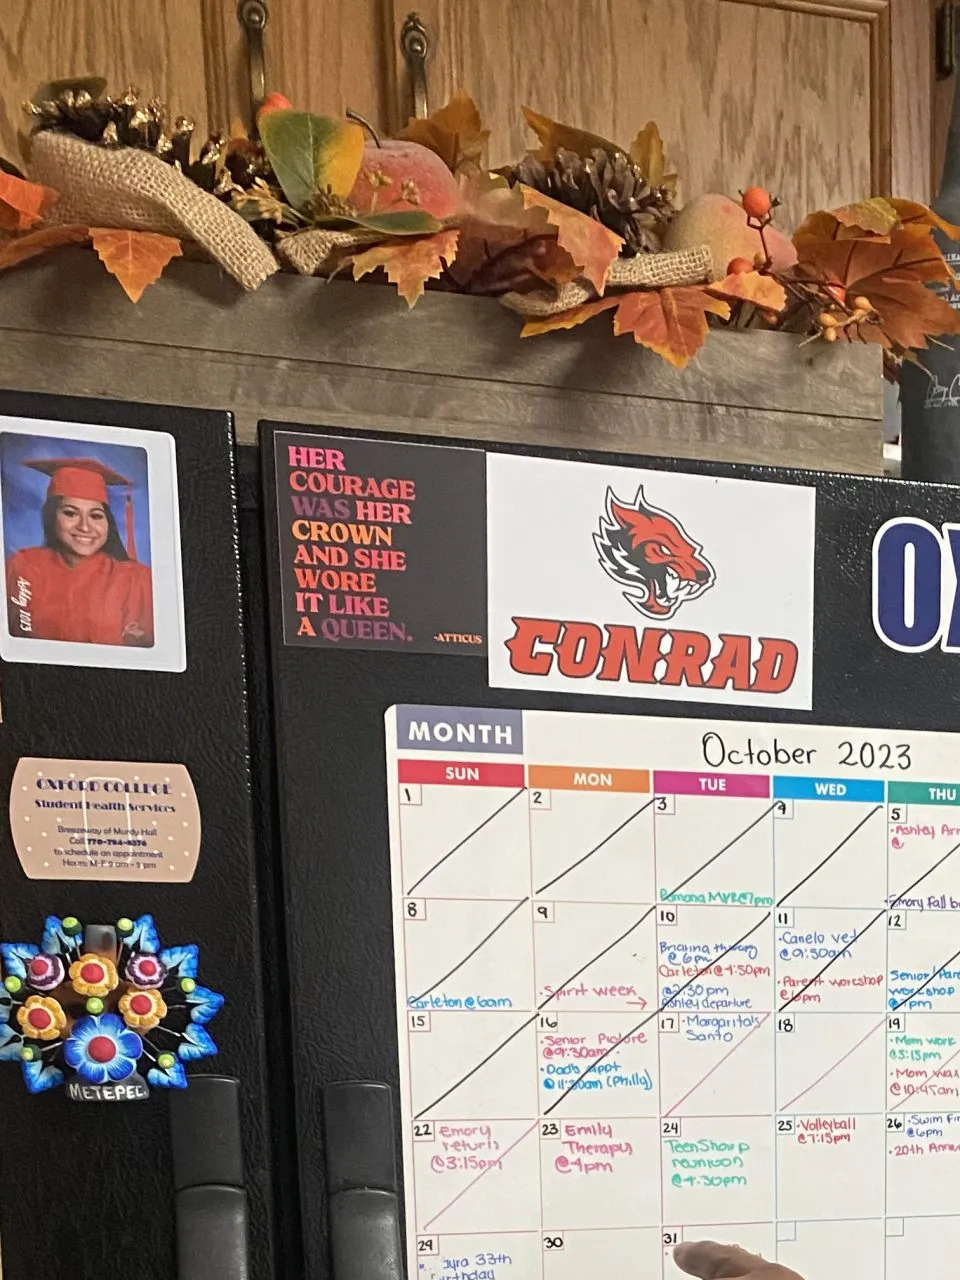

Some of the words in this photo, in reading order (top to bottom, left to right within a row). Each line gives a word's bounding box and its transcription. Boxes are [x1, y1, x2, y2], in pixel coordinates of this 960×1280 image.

[288, 446, 346, 471] HER
[290, 471, 416, 500] COURAGE
[291, 495, 350, 519] WAS
[356, 500, 412, 524] HER
[292, 520, 392, 546] CROWN
[294, 544, 348, 566] AND
[354, 549, 406, 571] SHE
[294, 568, 377, 593] WORE
[296, 593, 323, 612] IT
[329, 594, 390, 618] LIKE
[298, 616, 316, 637] A
[322, 618, 413, 642] QUEEN.
[434, 633, 482, 644] -ATTICUS
[503, 617, 799, 694] CONRAD
[409, 722, 512, 745] MONTH
[703, 732, 816, 767] October
[838, 741, 911, 770] 2023
[36, 778, 99, 792] OXFORD
[104, 781, 171, 794] COLLEGE
[445, 767, 479, 780] SUN
[573, 773, 612, 786] MON
[699, 778, 726, 792] TUE
[815, 783, 846, 796] WED
[929, 787, 956, 800] THU
[405, 788, 411, 801] 1
[533, 792, 542, 804] 2
[35, 800, 81, 810] Student
[128, 803, 176, 812] Services
[657, 797, 667, 810] 3
[891, 808, 900, 820] 5
[407, 903, 417, 917] 8
[537, 906, 547, 919] 9
[661, 910, 675, 922] 10
[779, 913, 788, 924] 11
[888, 915, 901, 926] 12
[783, 931, 824, 944] Canelo
[783, 976, 824, 987] Parent
[593, 985, 637, 996] week
[702, 997, 752, 1009] departure
[411, 1016, 425, 1027] 15
[541, 1017, 558, 1028] 16
[662, 1018, 673, 1029] 17
[778, 1018, 794, 1032] 18
[889, 1018, 900, 1030] 19
[544, 1035, 586, 1046] Senior
[598, 1032, 647, 1044] Picture
[687, 1029, 733, 1042] Santo
[896, 1035, 922, 1046] Mom
[896, 1068, 927, 1079] Mom
[778, 1120, 792, 1131] 25
[800, 1117, 856, 1132] Volleyball
[887, 1118, 902, 1129] 26
[911, 1115, 943, 1125] Swim
[414, 1124, 432, 1136] 22
[542, 1124, 558, 1136] 23
[565, 1125, 612, 1138] Emily
[664, 1123, 678, 1134] 24
[563, 1140, 632, 1155] Therapy
[895, 1145, 924, 1156] 20th
[544, 1237, 563, 1249] 30
[663, 1233, 677, 1244] 31
[418, 1240, 433, 1251] 29
[476, 1253, 511, 1265] 33th
